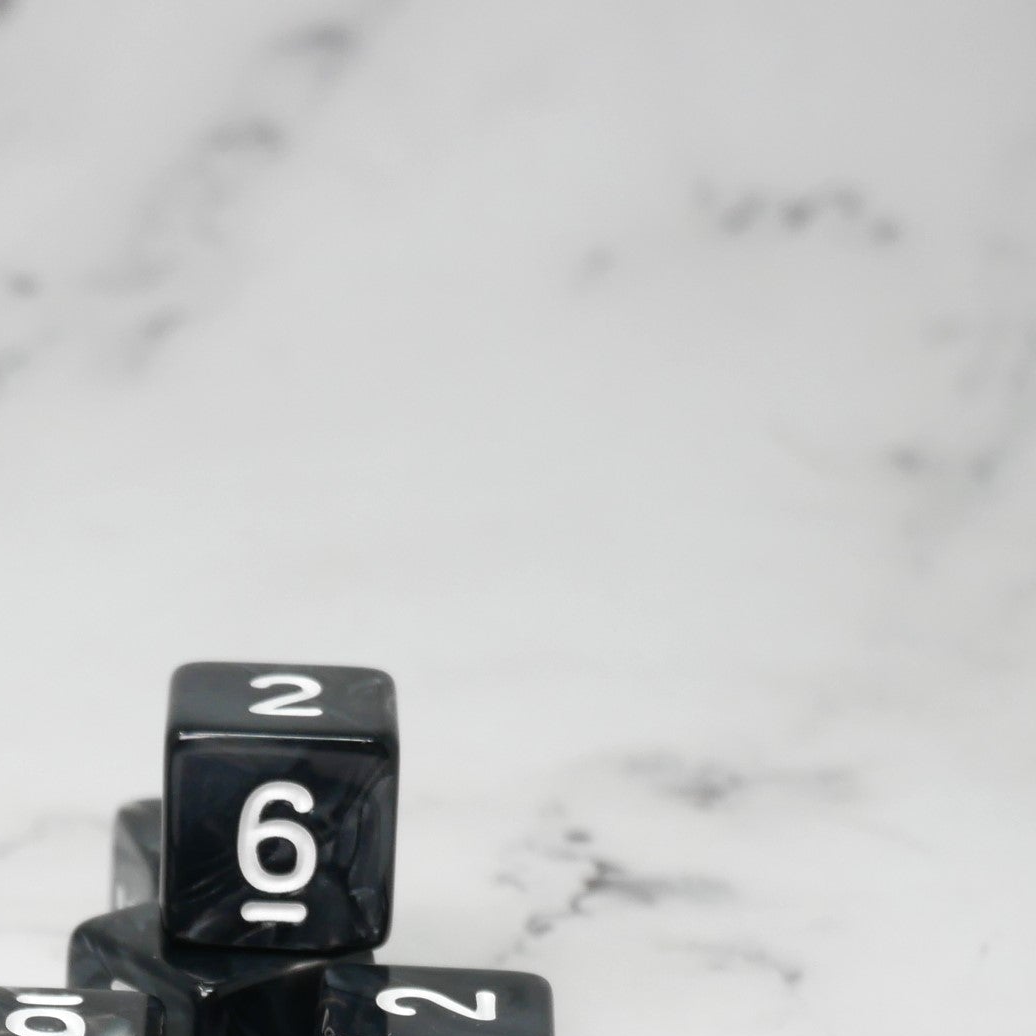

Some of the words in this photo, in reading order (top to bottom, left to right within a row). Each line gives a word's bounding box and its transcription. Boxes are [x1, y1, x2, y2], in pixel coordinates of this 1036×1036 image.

[248, 674, 324, 718] 2
[237, 781, 317, 923] 6
[375, 987, 497, 1022] 2
